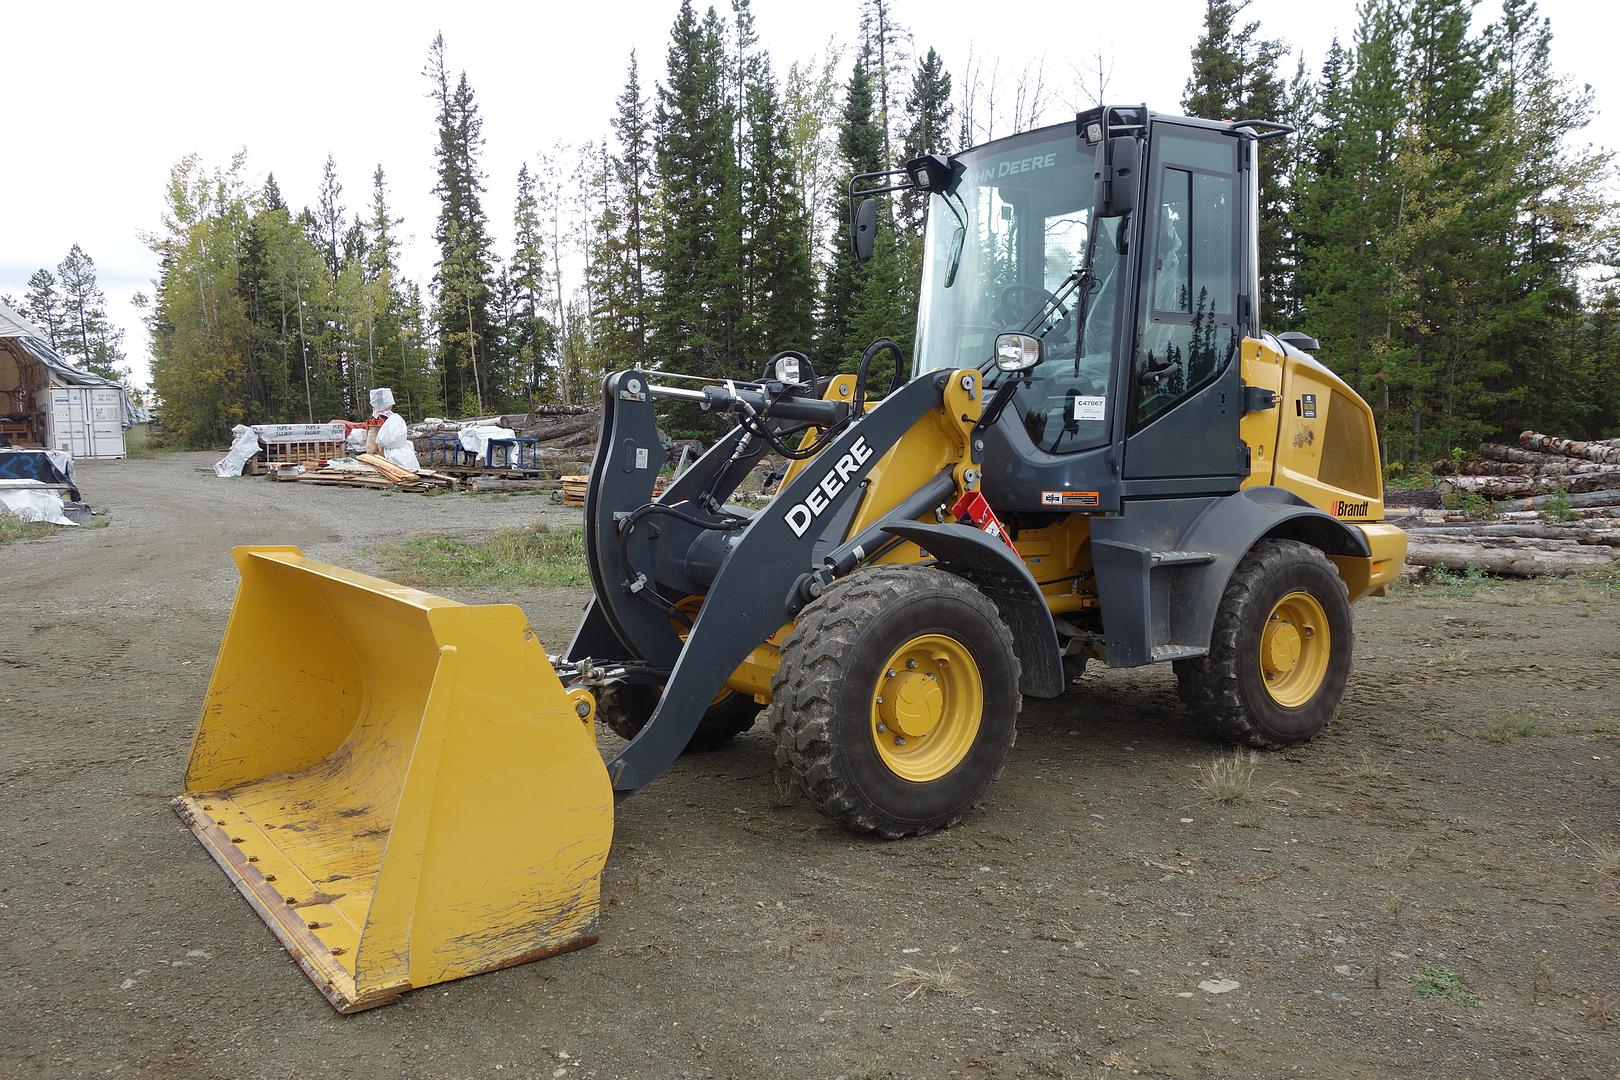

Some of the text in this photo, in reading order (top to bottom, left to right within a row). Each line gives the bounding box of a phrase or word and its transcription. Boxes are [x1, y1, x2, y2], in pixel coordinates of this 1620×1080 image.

[998, 152, 1057, 178] DEERE
[784, 436, 874, 538] DEERE
[1337, 500, 1369, 516] Brandt
